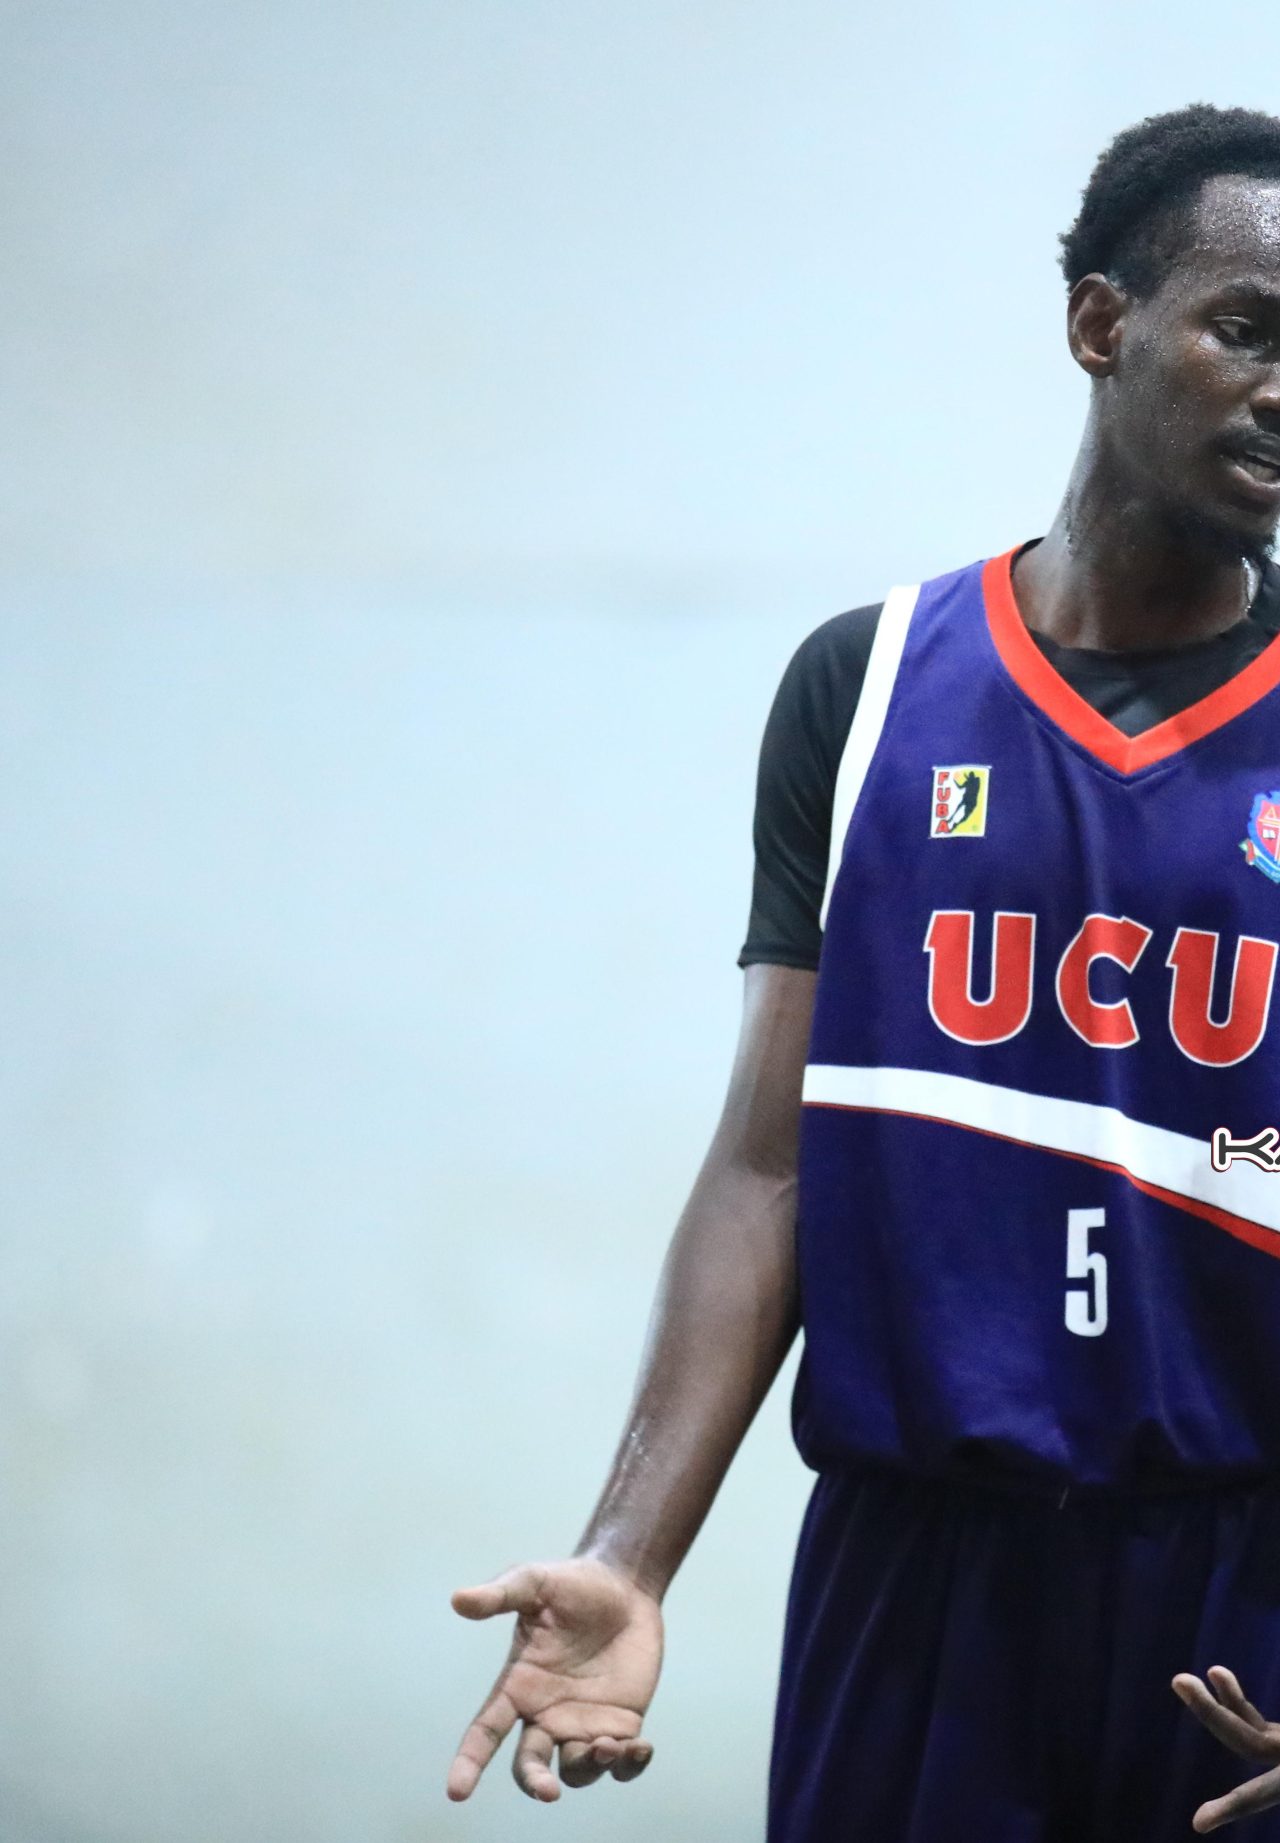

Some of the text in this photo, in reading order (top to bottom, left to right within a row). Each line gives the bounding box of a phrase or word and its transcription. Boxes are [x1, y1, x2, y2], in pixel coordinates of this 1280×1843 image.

[935, 771, 951, 834] FUBA
[923, 909, 1279, 1067] UCU
[1065, 1207, 1108, 1337] 5
